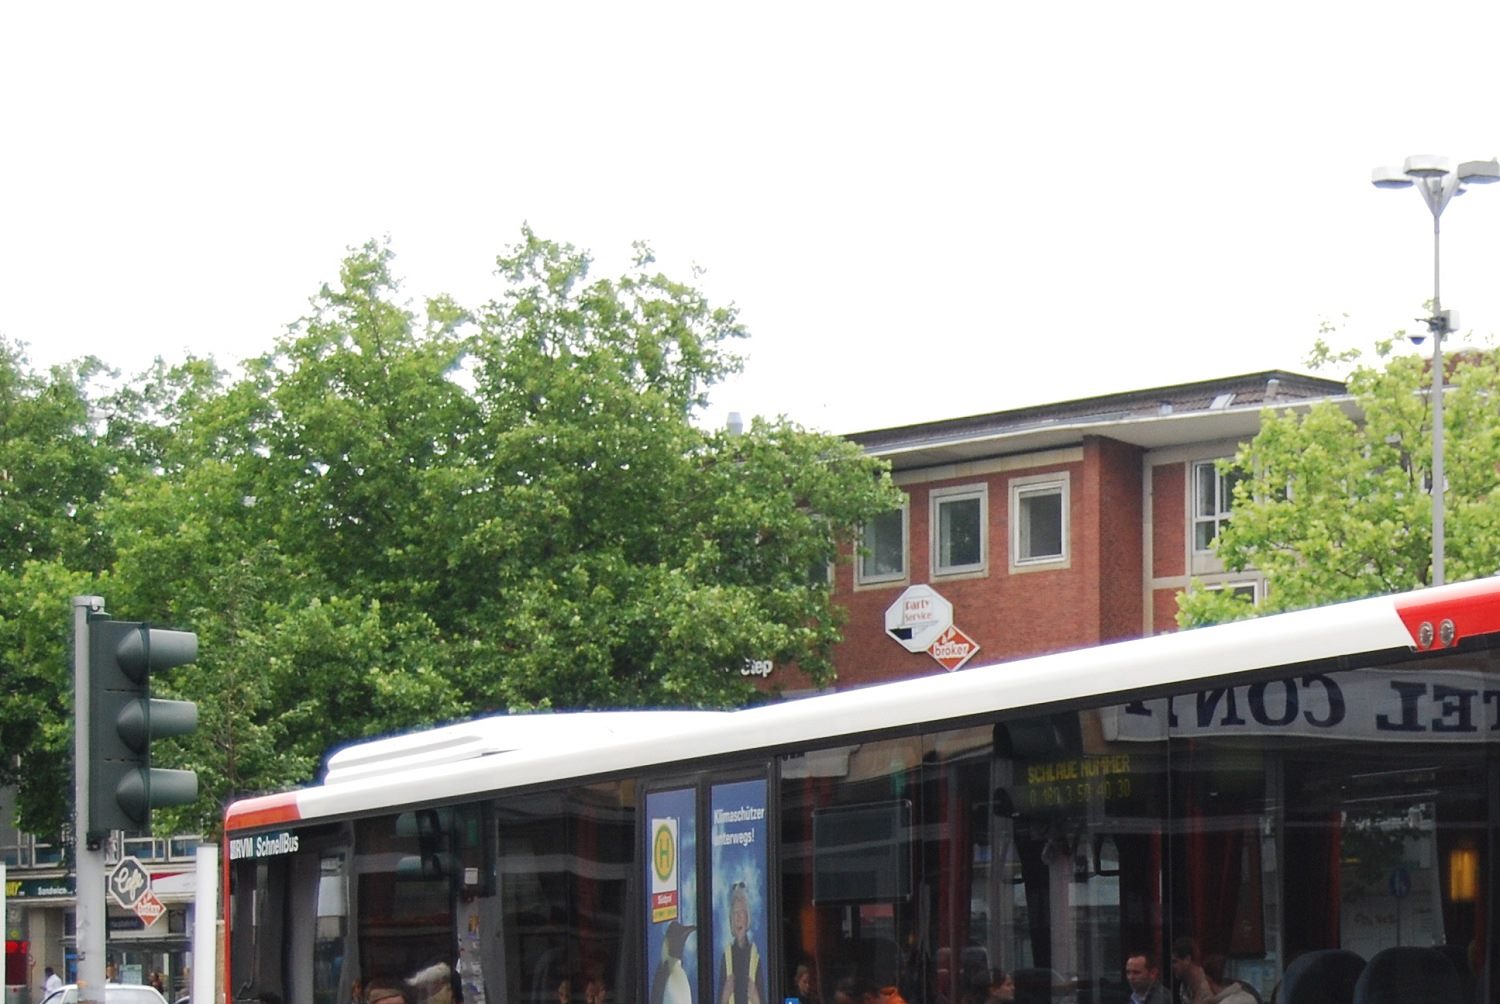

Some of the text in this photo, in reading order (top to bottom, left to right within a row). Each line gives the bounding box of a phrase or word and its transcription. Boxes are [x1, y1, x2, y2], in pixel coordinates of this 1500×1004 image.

[905, 599, 930, 611] Party
[236, 831, 299, 859] RVM SchnellBus
